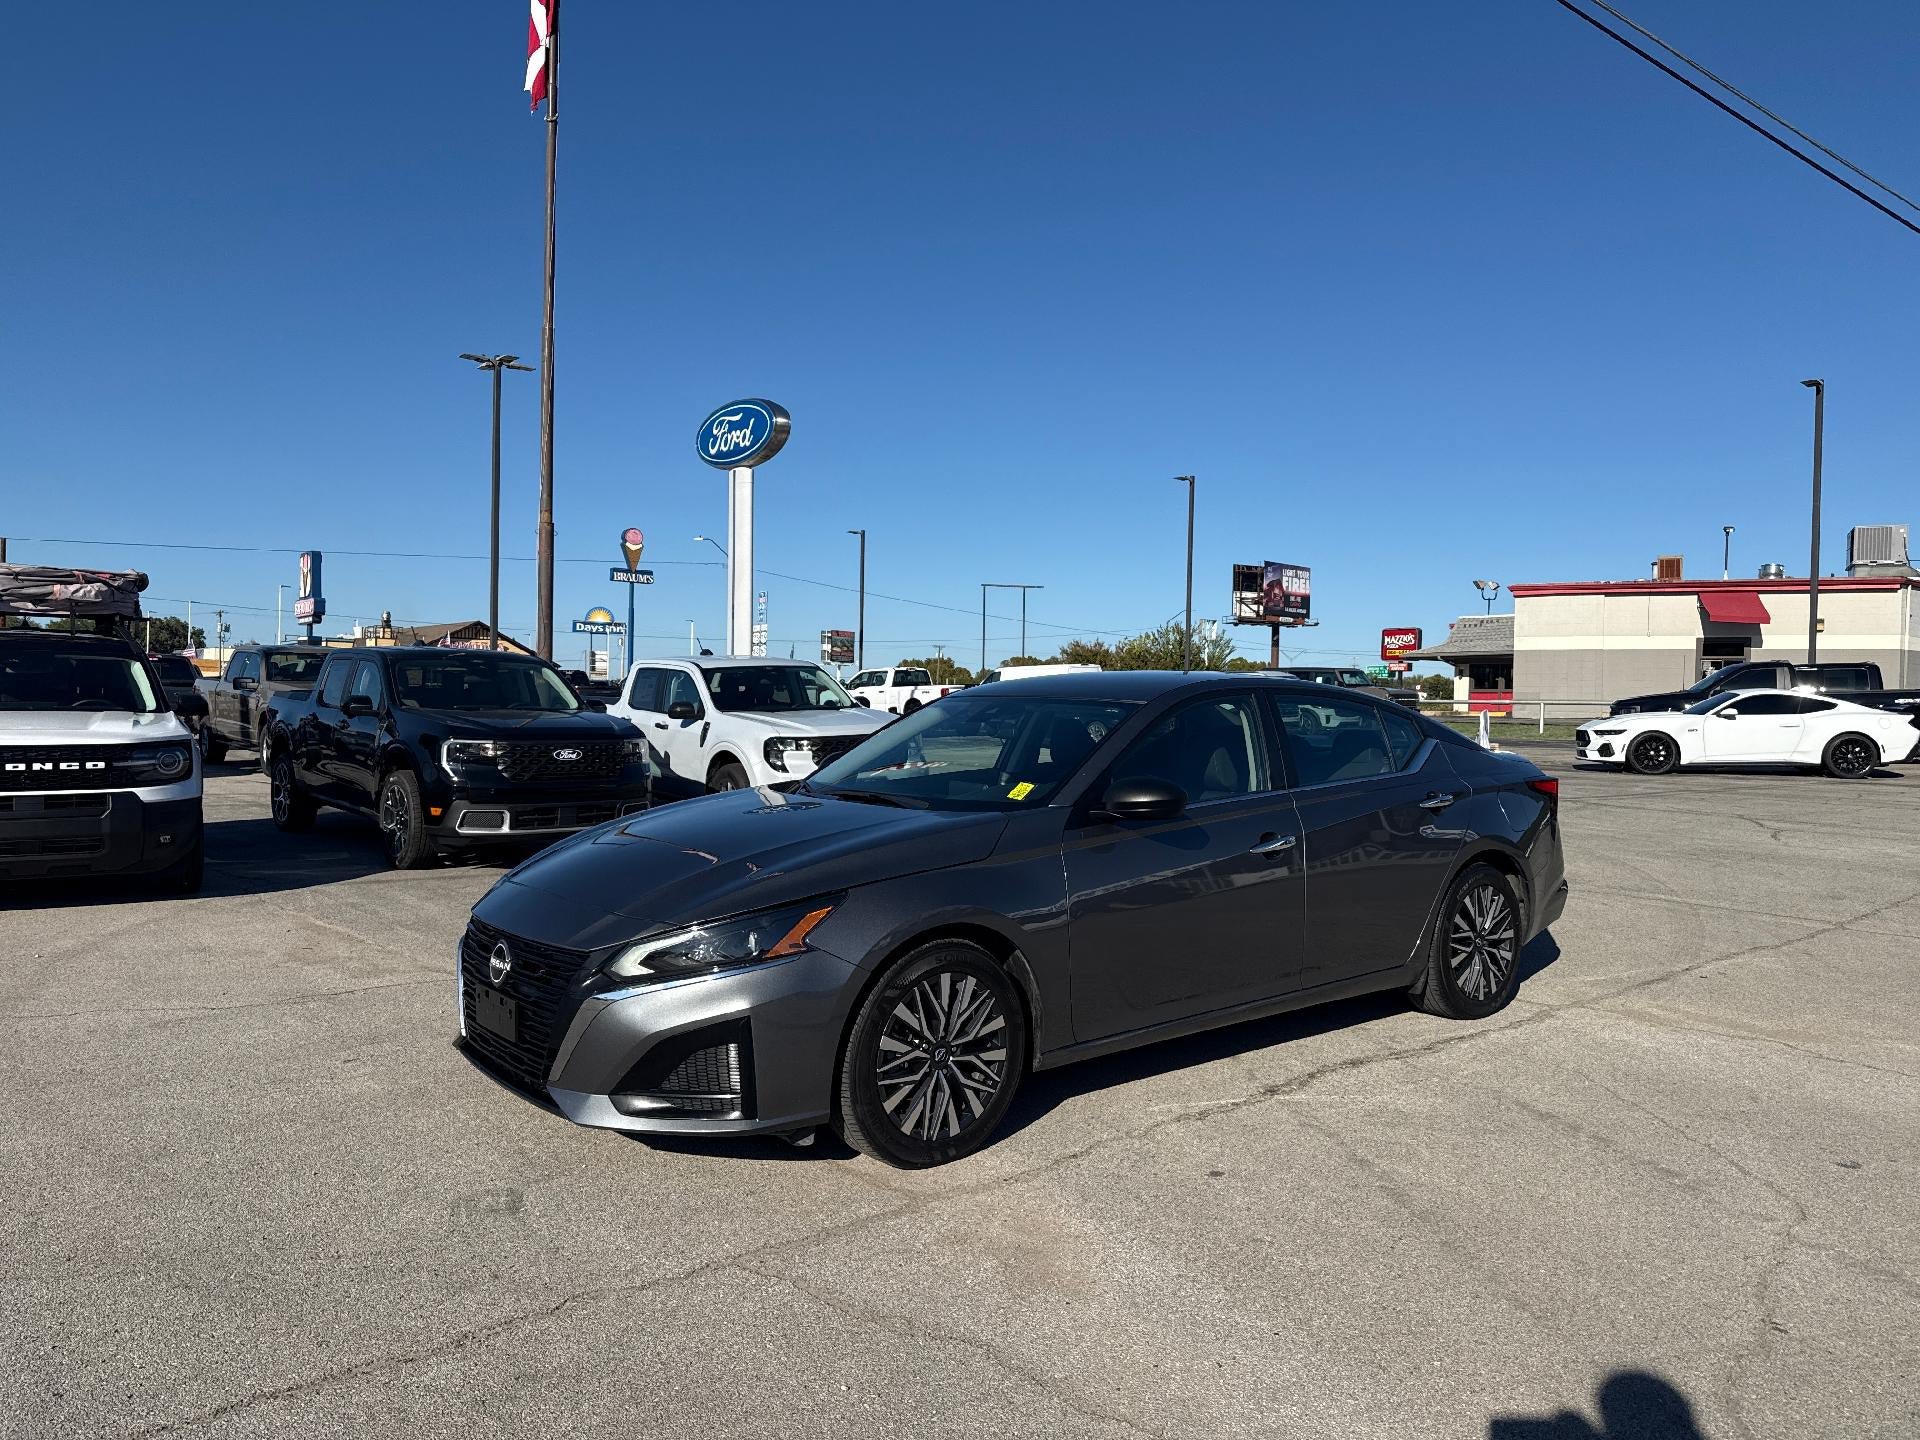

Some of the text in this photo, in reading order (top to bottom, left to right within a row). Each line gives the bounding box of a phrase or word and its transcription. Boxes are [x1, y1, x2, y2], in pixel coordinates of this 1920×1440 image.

[708, 412, 755, 455] Ford
[613, 571, 654, 584] BRAUM'S
[576, 623, 604, 632] Days
[1384, 633, 1416, 646] MAZZIO'S
[559, 749, 578, 759] Ford
